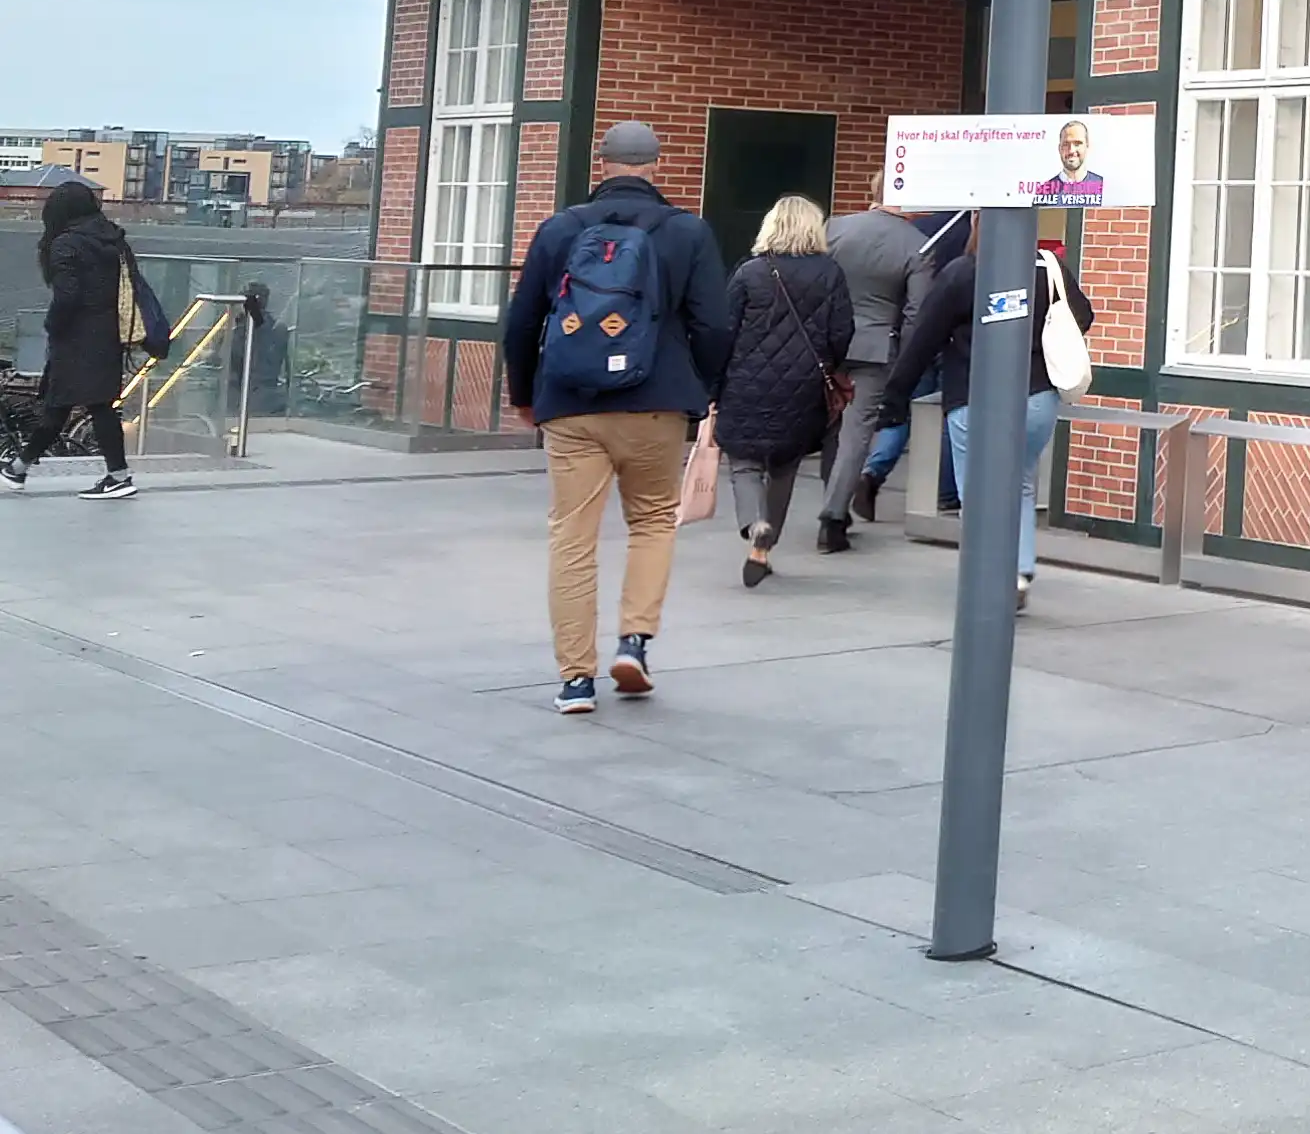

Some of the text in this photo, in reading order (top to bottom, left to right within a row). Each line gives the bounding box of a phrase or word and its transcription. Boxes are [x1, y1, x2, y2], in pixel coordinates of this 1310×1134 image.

[897, 129, 1046, 142] Hvor høj skal flyafgiften være?
[1061, 194, 1102, 204] VENSTRE
